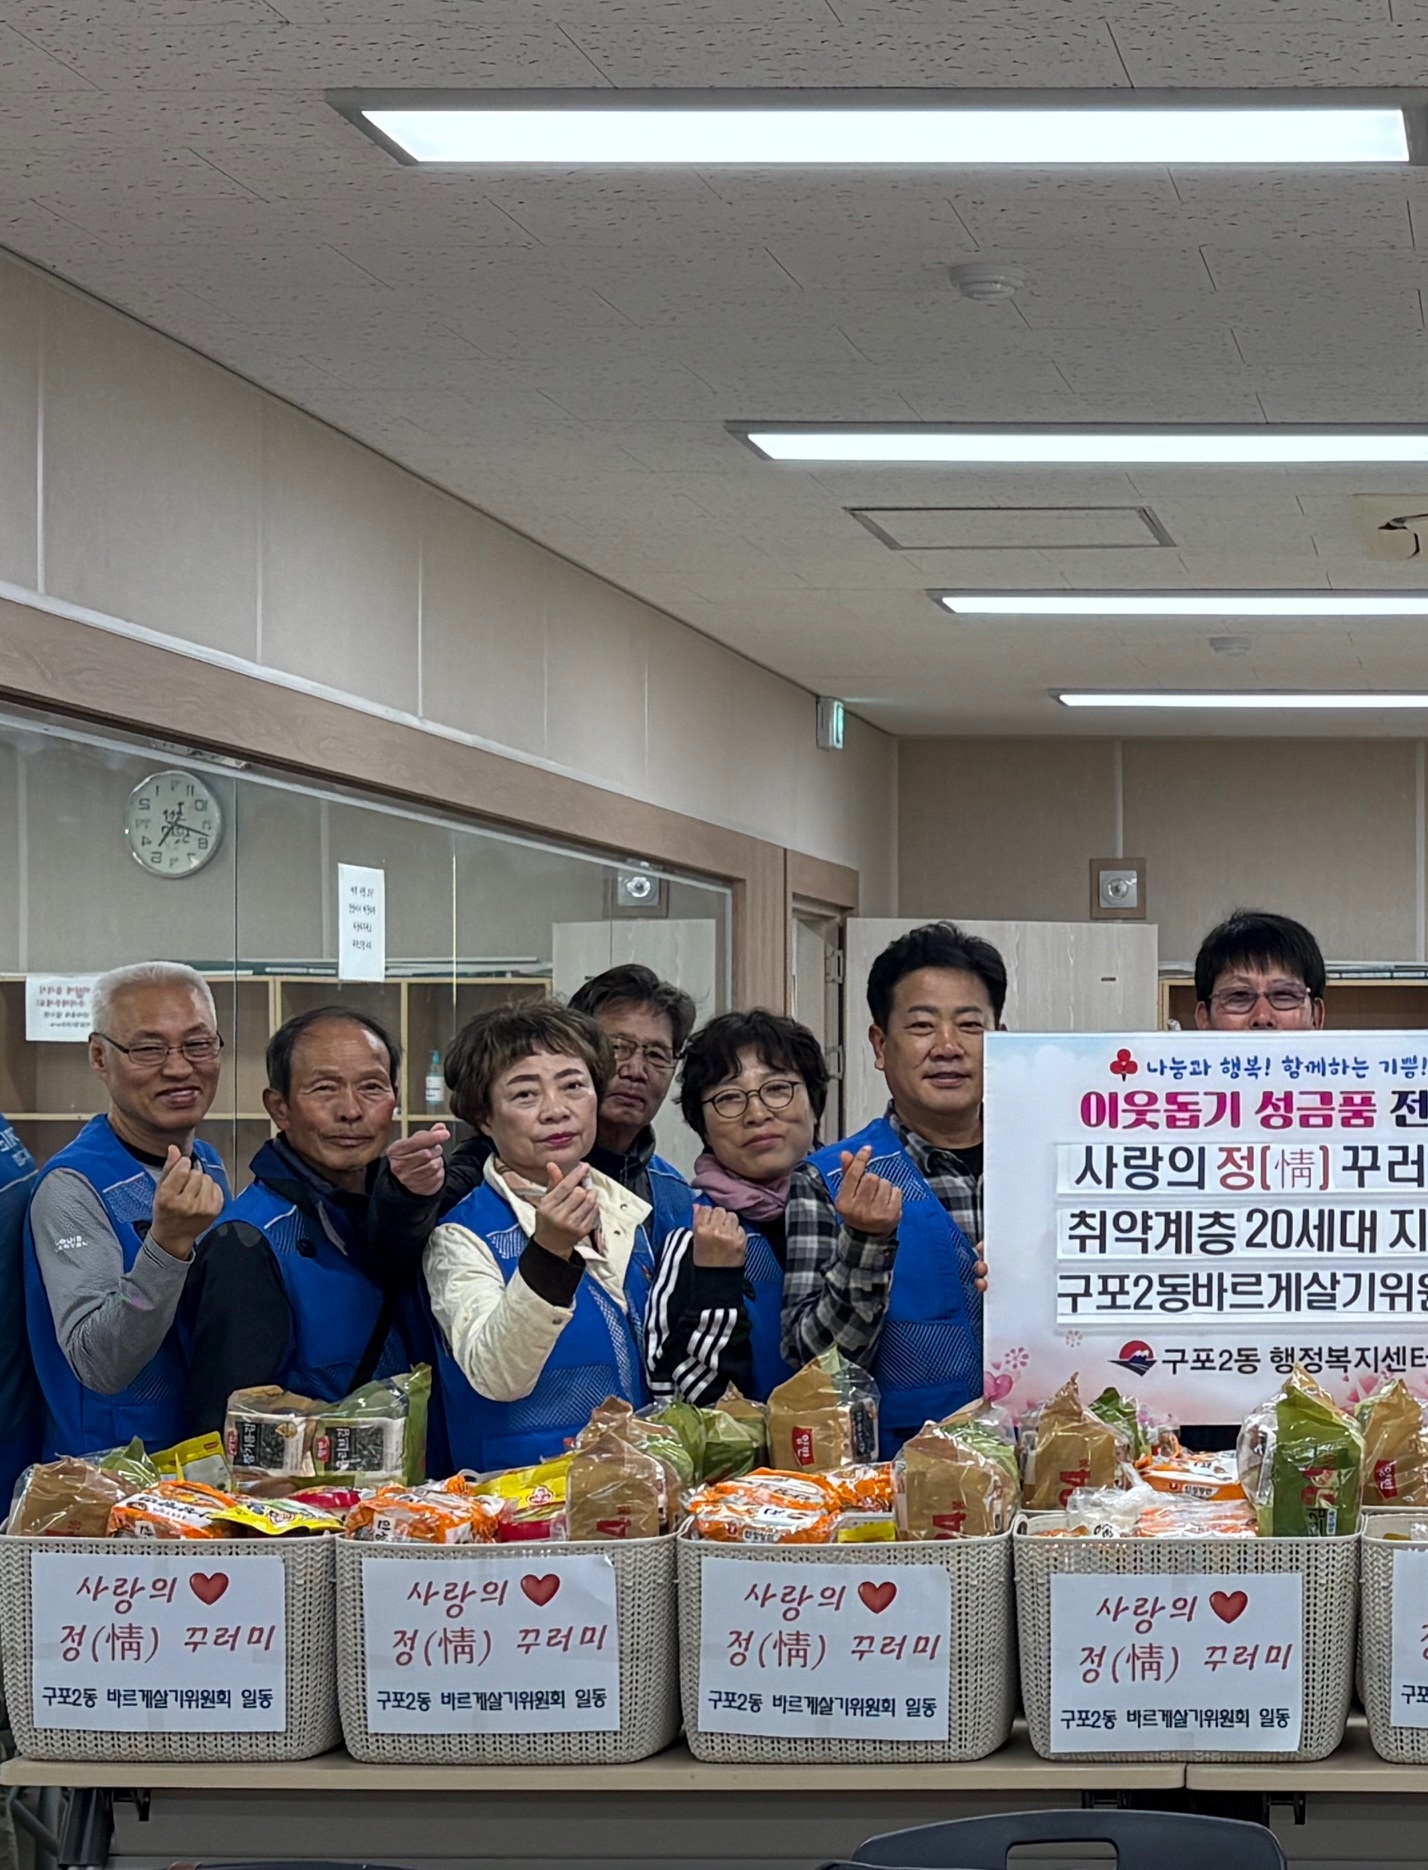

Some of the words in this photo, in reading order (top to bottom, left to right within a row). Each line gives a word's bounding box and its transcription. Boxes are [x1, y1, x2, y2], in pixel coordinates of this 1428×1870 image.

[1219, 1055, 1271, 1080] 행복!
[1281, 1055, 1370, 1079] 함께하는
[1378, 1055, 1428, 1079] 기쁨!
[1080, 1090, 1241, 1130] 이웃돕기
[1254, 1090, 1378, 1130] 성금품
[1074, 1145, 1206, 1191] 사랑의
[1067, 1209, 1238, 1256] 취약계층
[1245, 1208, 1378, 1254] 20세대
[1161, 1347, 1261, 1375] 구포2동
[76, 1576, 177, 1614] 사랑의
[407, 1580, 508, 1618] 사랑의
[744, 1583, 846, 1621] 사랑의
[1096, 1596, 1198, 1634] 사랑의
[60, 1623, 158, 1663] 정(情)
[184, 1625, 275, 1653] 꾸러미
[393, 1627, 491, 1666] 정(情)
[517, 1625, 607, 1654] 꾸러미
[727, 1630, 825, 1670] 정(情)
[851, 1635, 941, 1661] 꾸러미
[1079, 1643, 1178, 1683] 정(情)
[1204, 1644, 1292, 1672] 꾸러미
[42, 1687, 98, 1708] 구포2동
[107, 1689, 231, 1709] 바르게살기위원회
[241, 1689, 273, 1709] 일동
[377, 1691, 431, 1712] 구포2동
[441, 1690, 565, 1711] 바르게살기위원회
[575, 1688, 607, 1708] 일동
[708, 1690, 763, 1713] 구포2동
[773, 1695, 895, 1717] 바르게살기위원회
[906, 1698, 937, 1718] 일동
[1061, 1710, 1117, 1730] 구포2동
[1127, 1709, 1249, 1729] 바르게살기위원회
[1259, 1708, 1290, 1728] 일동
